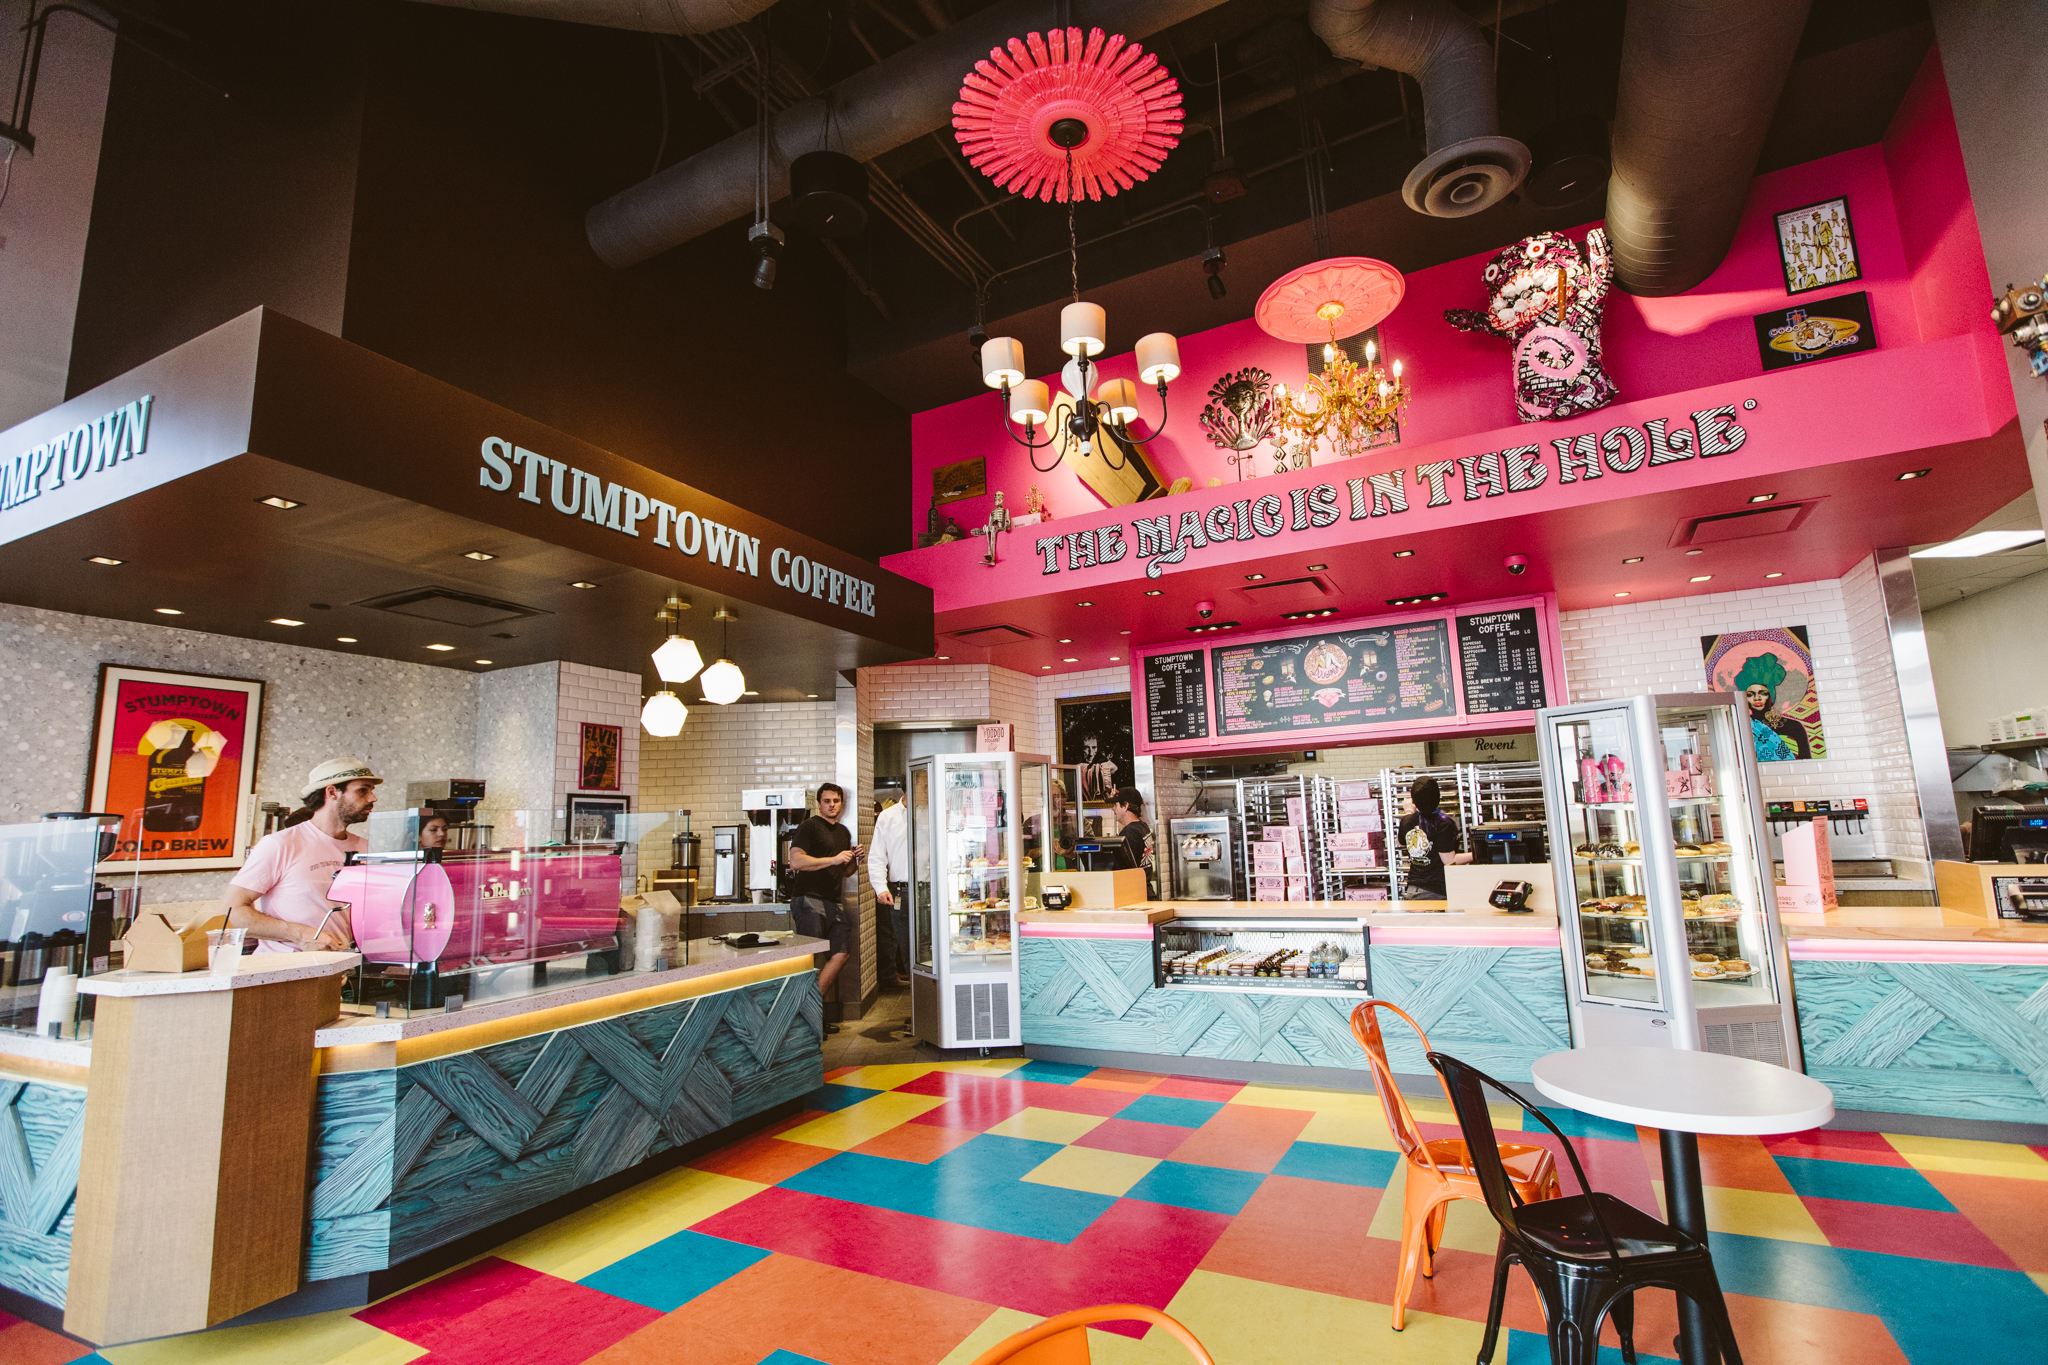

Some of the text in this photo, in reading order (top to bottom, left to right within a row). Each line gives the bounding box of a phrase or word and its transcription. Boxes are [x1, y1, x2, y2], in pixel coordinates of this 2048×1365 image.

[1036, 523, 1127, 575] THE
[1132, 494, 1285, 579] MAGIC
[1289, 483, 1341, 531] IS
[1346, 469, 1410, 520] IN
[1415, 443, 1548, 508] THE
[479, 436, 876, 617] STUMPTOWN COFFEE
[1470, 612, 1520, 626] STUMPTOWN
[1478, 622, 1511, 634] COFFEE
[1155, 653, 1193, 664] STUMPTOWN
[1162, 662, 1186, 672] COFFEE
[124, 694, 240, 721] STUMPTOWN
[147, 709, 177, 717] COFFEE
[584, 725, 617, 746] ELVIS
[980, 726, 1004, 739] VOODOO
[1474, 738, 1516, 751] Revent
[171, 838, 229, 850] BREW
